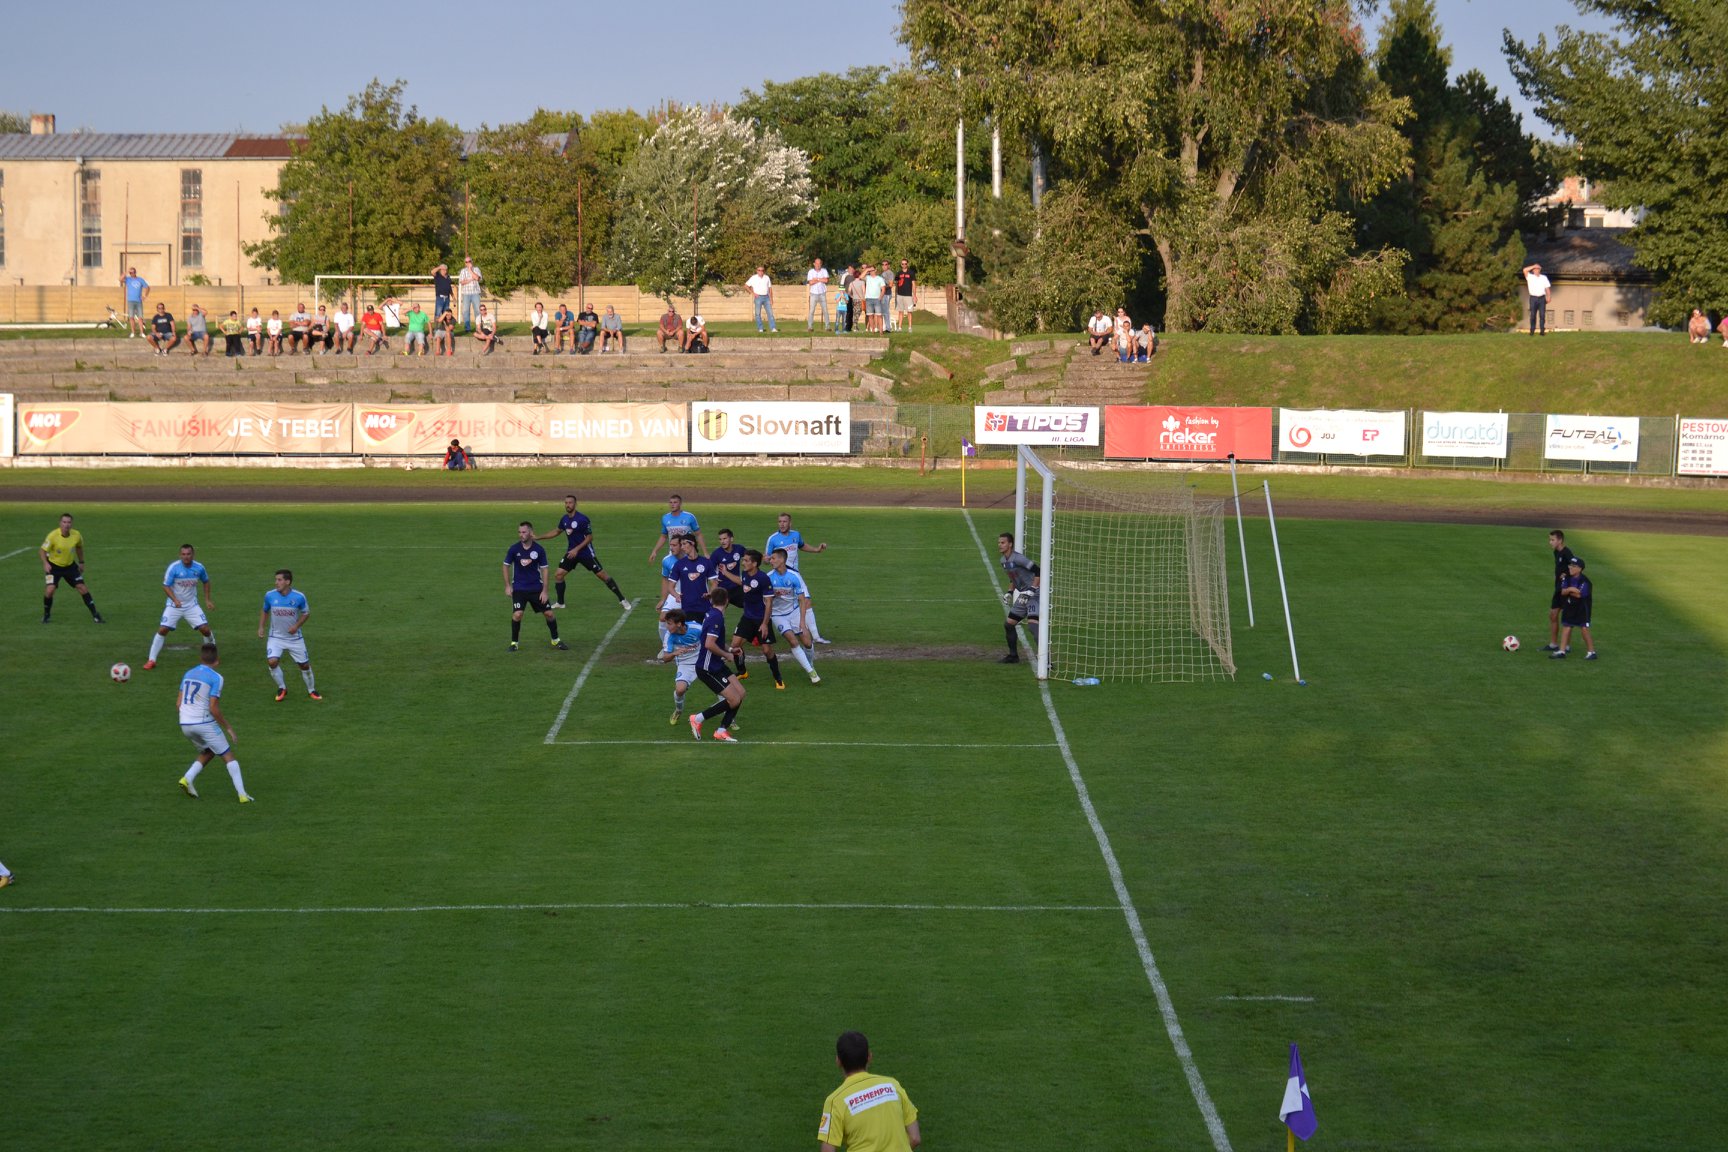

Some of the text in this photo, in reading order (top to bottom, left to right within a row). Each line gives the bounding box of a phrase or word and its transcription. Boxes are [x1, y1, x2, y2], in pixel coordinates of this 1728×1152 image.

[30, 413, 62, 428] MOL
[227, 417, 253, 437] JE
[259, 418, 273, 437] V
[278, 418, 340, 438] TEBE!
[365, 414, 397, 429] MOL
[550, 418, 634, 439] BENNED
[639, 418, 686, 438] VAN!
[738, 414, 842, 436] Slovnaft
[1010, 413, 1085, 431] TIPOS
[1185, 416, 1219, 429] fashion by
[1682, 422, 1728, 433] PESTOV
[1160, 428, 1217, 444] rieker
[1362, 429, 1380, 441] EP
[1427, 420, 1504, 446] dunatáj
[1550, 429, 1618, 440] FUTBAL
[184, 680, 202, 705] 17
[848, 1086, 894, 1107] PESMEMPOL
